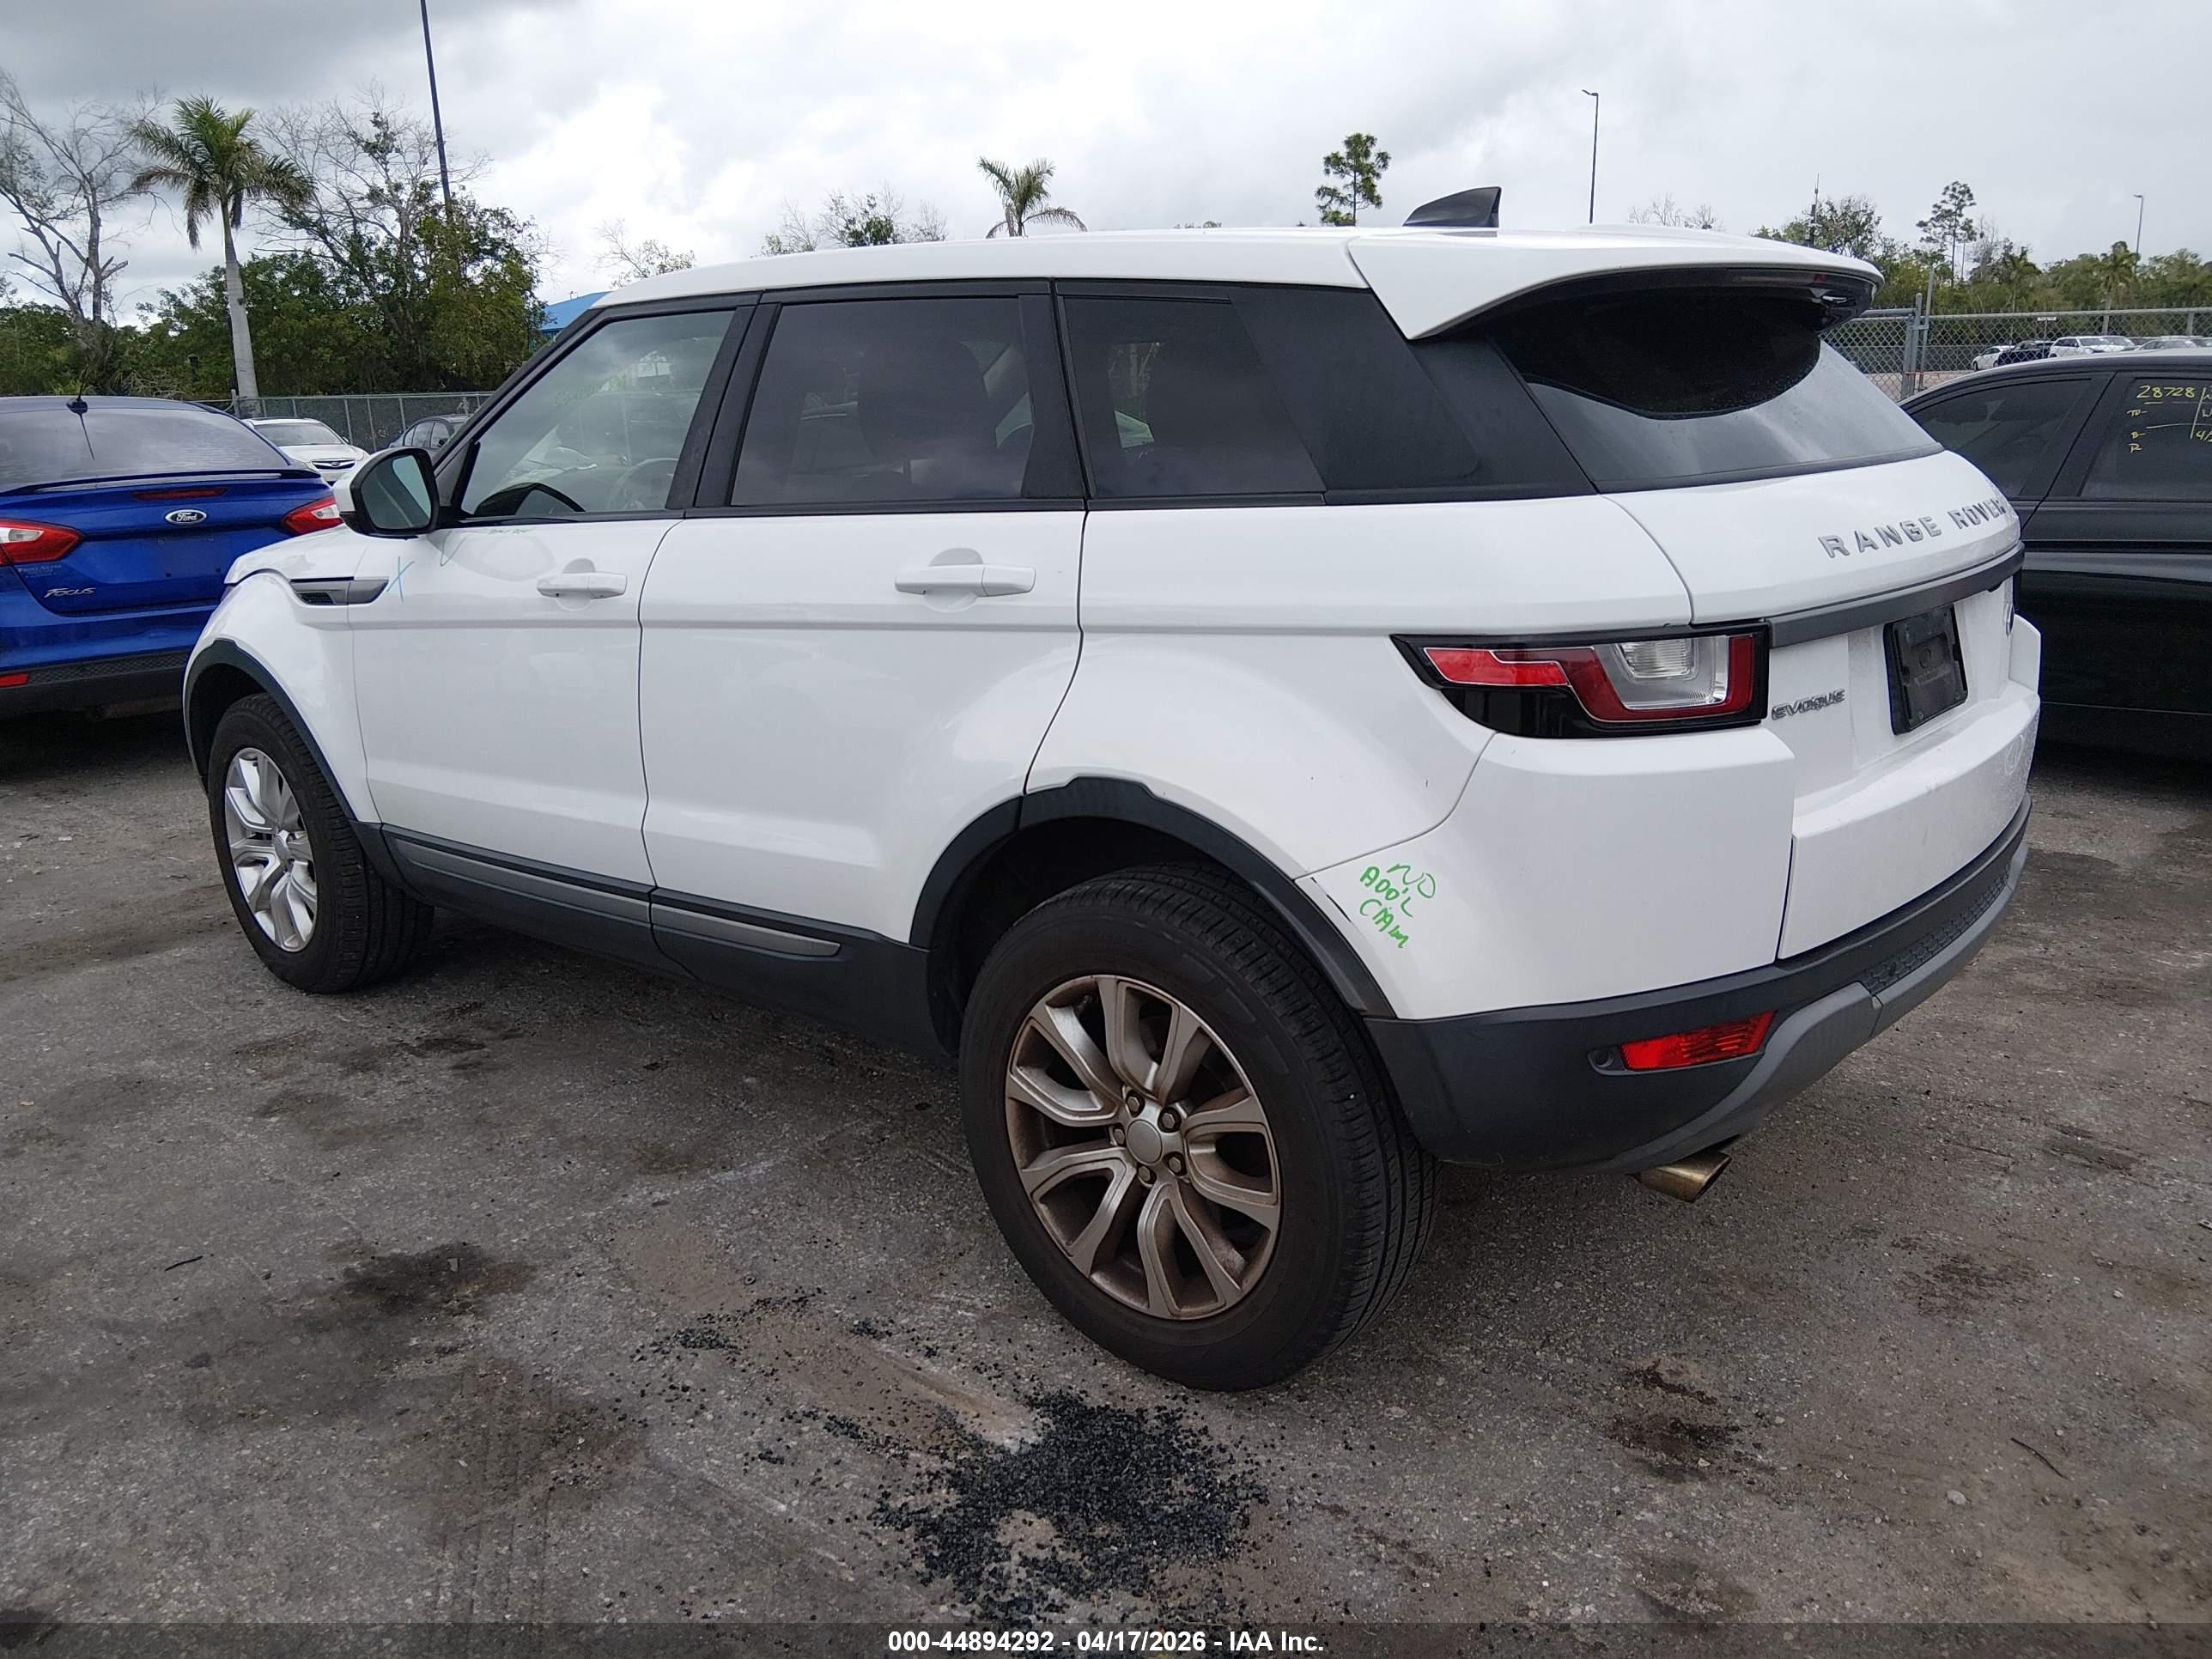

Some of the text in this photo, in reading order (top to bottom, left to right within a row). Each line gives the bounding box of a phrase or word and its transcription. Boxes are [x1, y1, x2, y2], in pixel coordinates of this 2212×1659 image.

[2136, 385, 2195, 398] 28728
[176, 512, 198, 521] Ford
[1818, 498, 2007, 558] RANGE ROVER
[1771, 690, 1844, 720] EVOQUE
